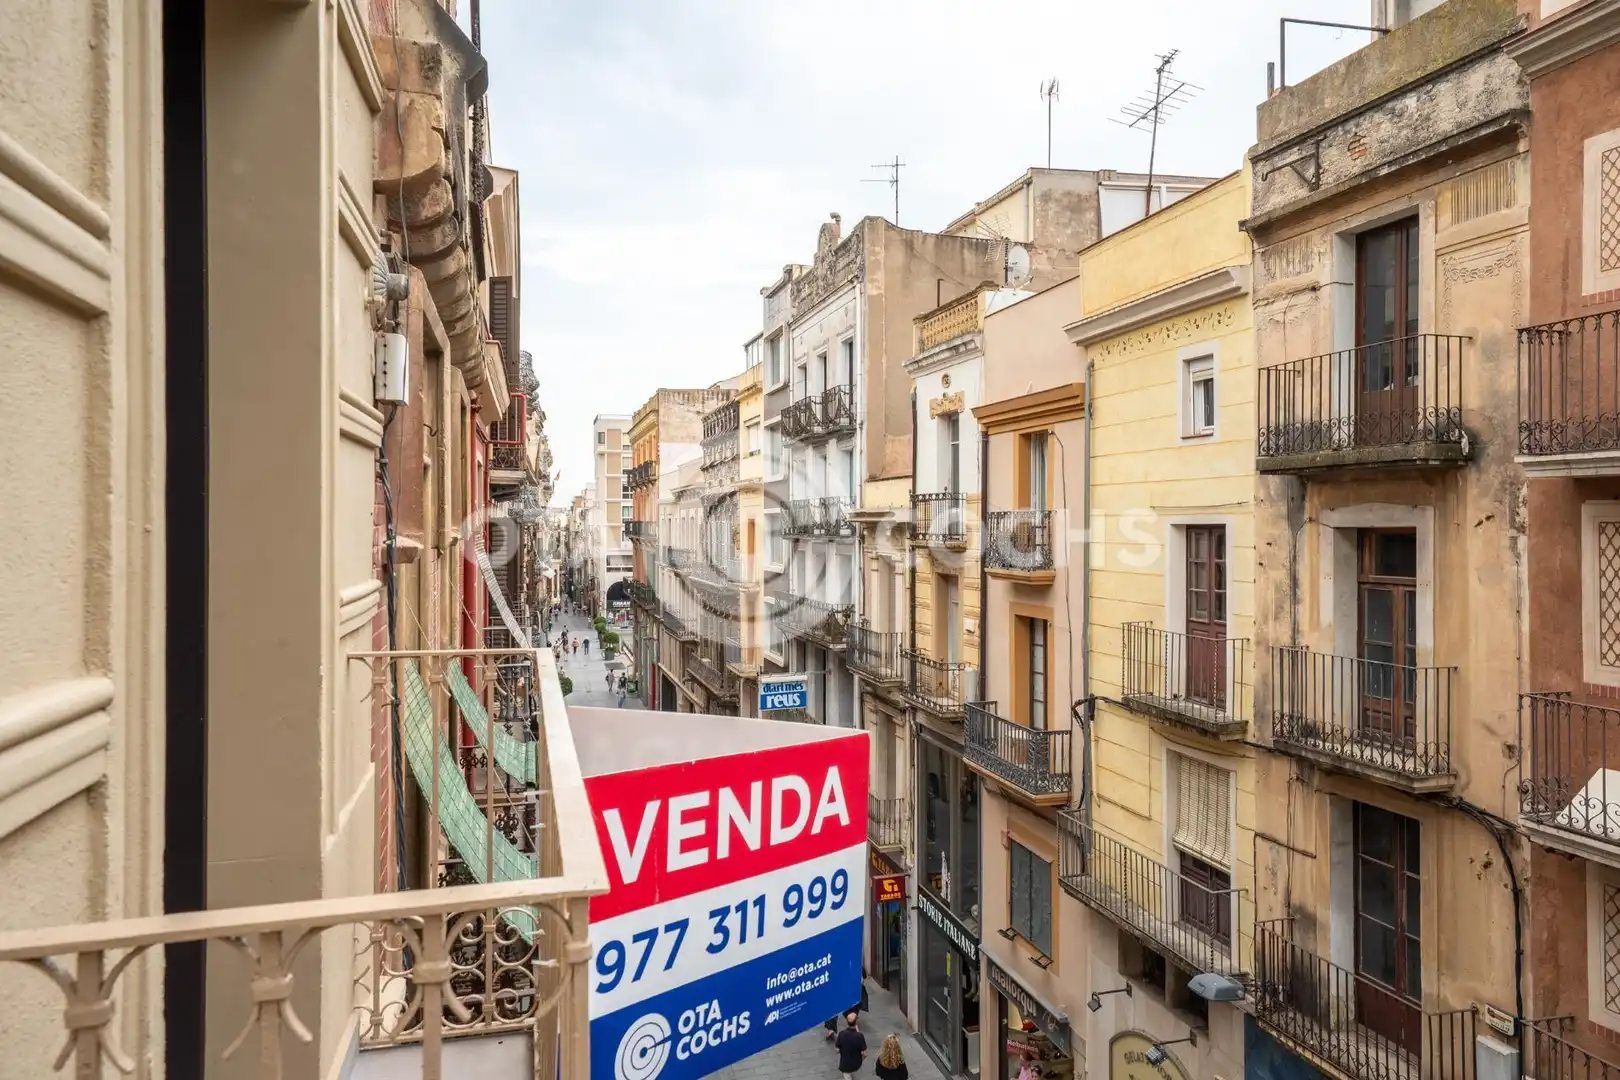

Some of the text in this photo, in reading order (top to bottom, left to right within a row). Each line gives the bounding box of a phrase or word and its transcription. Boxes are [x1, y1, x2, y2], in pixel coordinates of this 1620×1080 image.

[766, 692, 801, 709] reus
[602, 765, 850, 886] VENDA
[595, 867, 849, 994] 977 311 999
[918, 893, 943, 928] STORIE
[943, 916, 976, 961] ITALIANE
[765, 970, 830, 1008] www.ota.cat
[766, 952, 832, 990] info@ota.cat
[676, 1011, 750, 1061] COCHS
[678, 999, 722, 1034] OTA
